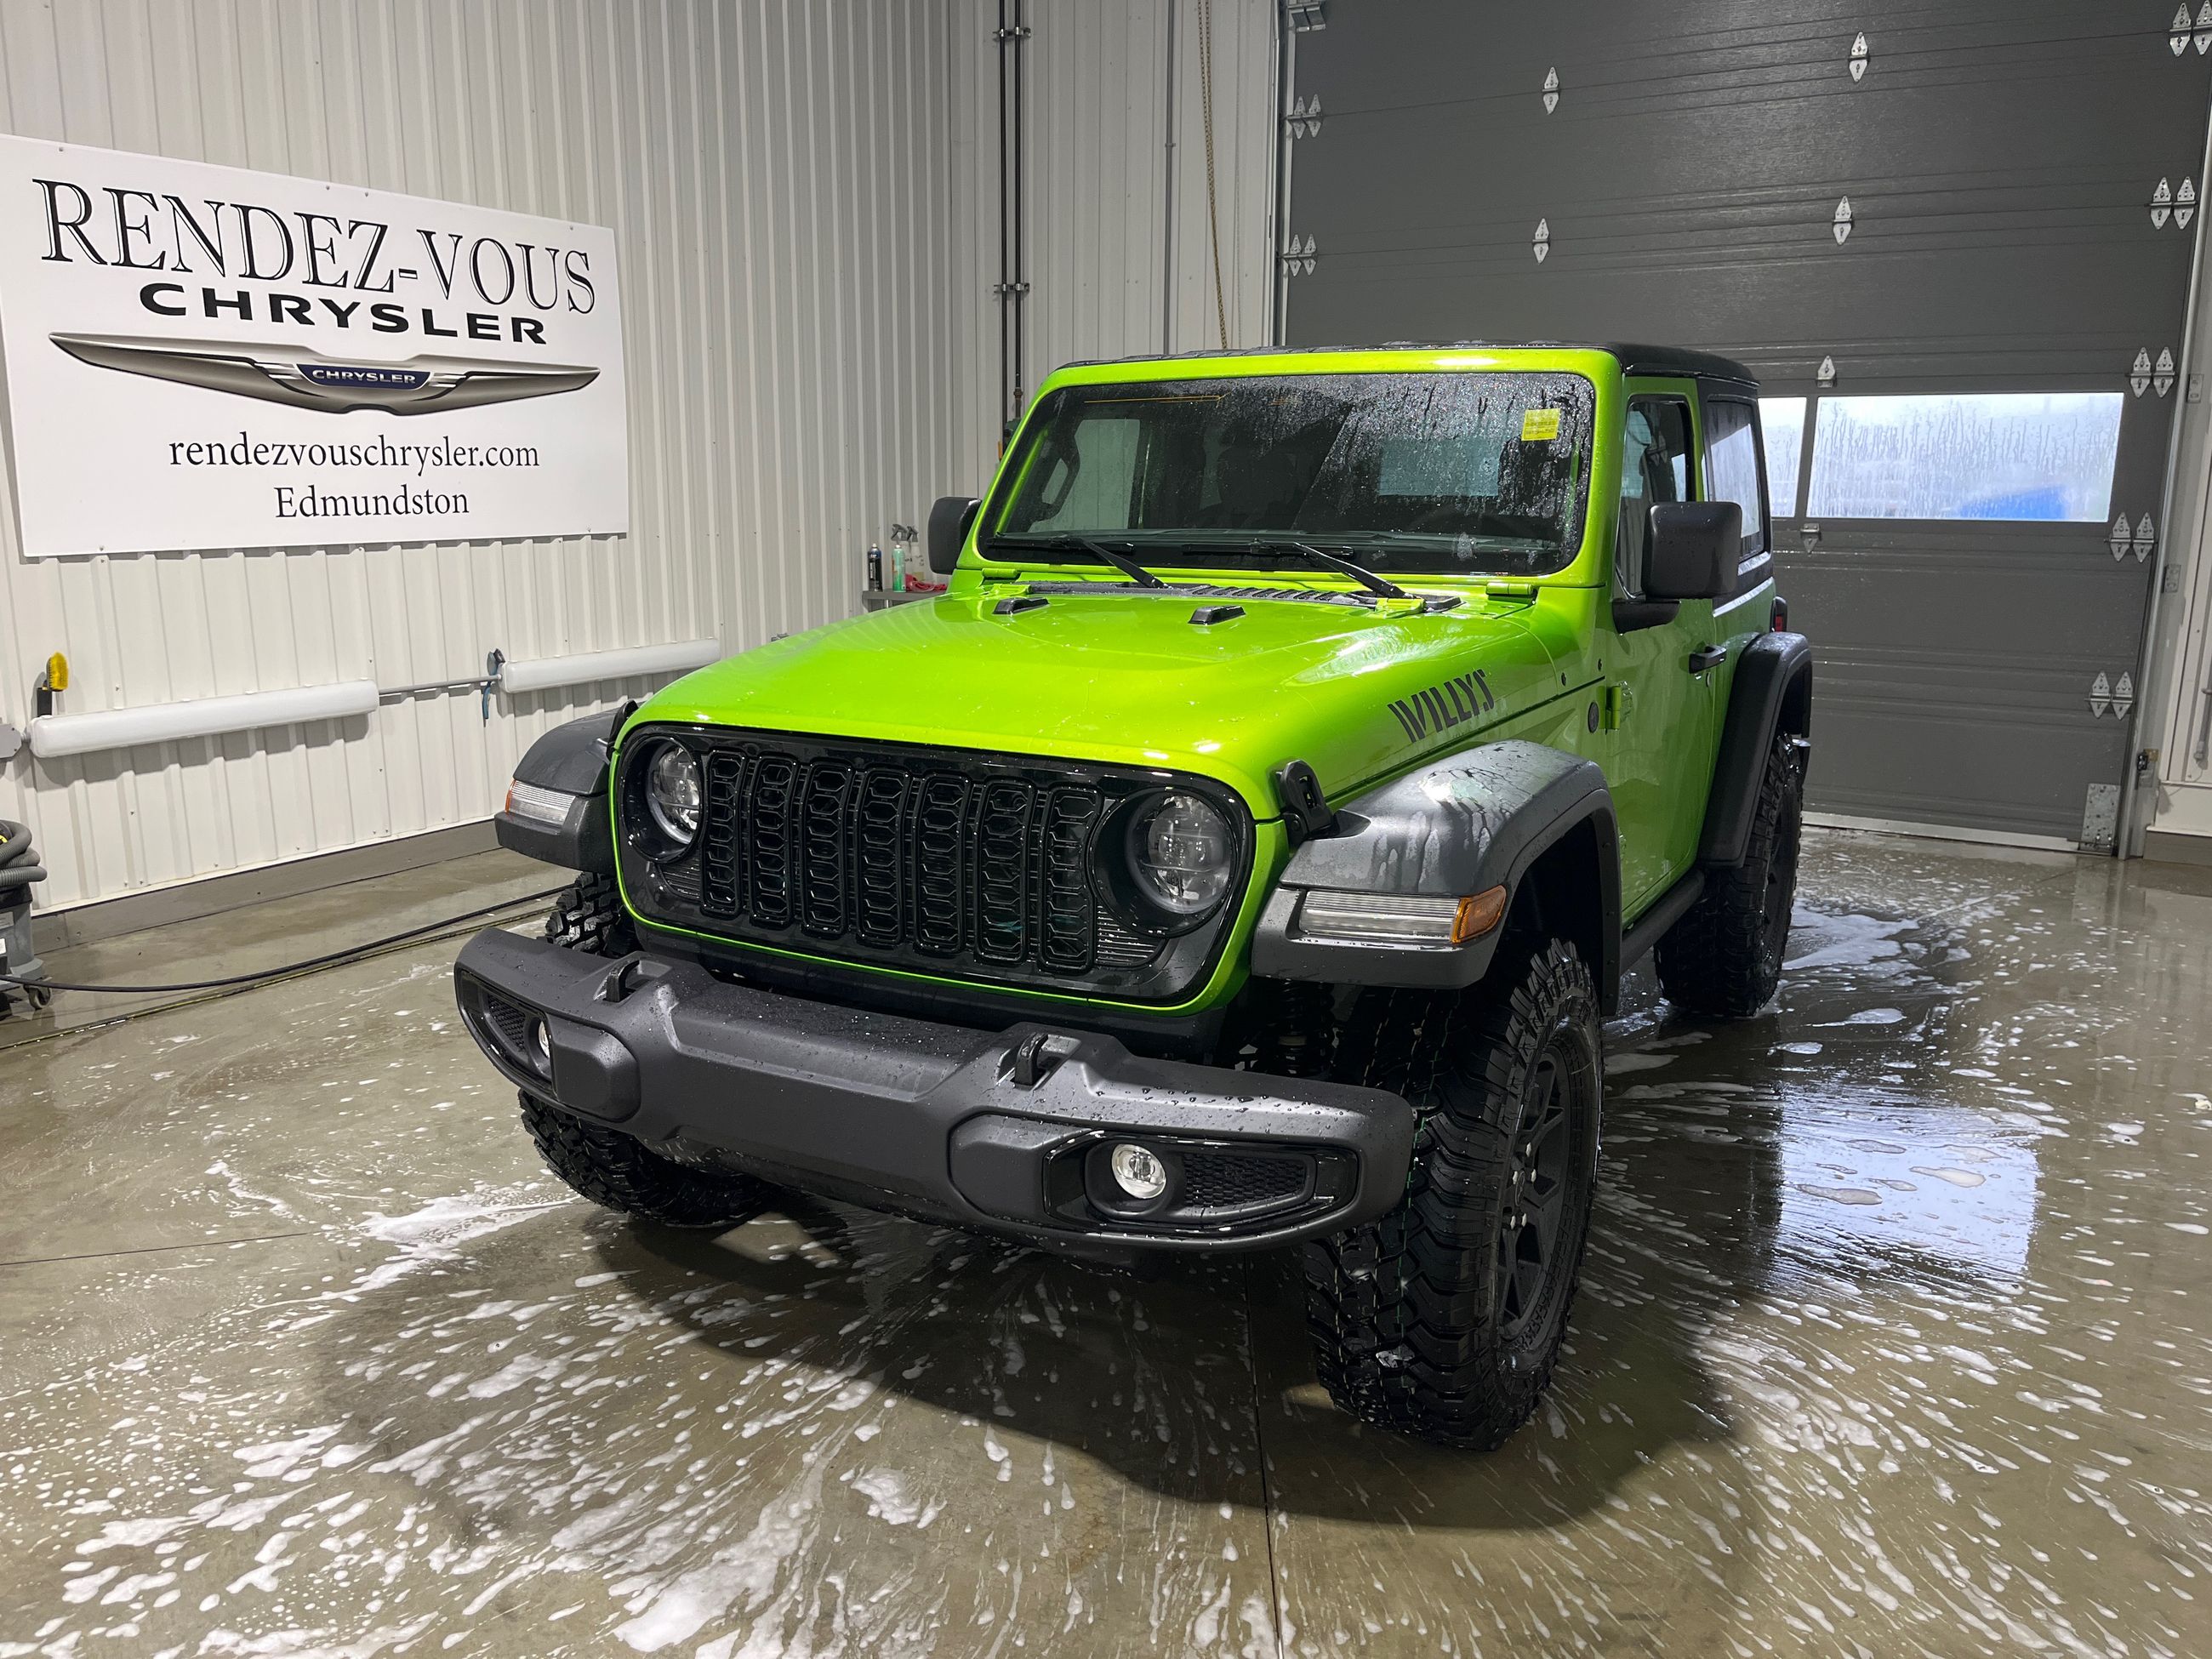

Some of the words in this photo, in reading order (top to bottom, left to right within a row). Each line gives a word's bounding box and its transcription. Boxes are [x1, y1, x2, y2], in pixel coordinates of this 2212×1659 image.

[31, 178, 596, 314] RENDEZ-VOUS
[140, 282, 547, 345] CHRYSLER
[312, 369, 416, 384] CHRYSLER
[169, 431, 539, 477] rendezvouschrysler.com
[274, 484, 470, 518] Edmundston
[1388, 669, 1495, 743] WILLYS
